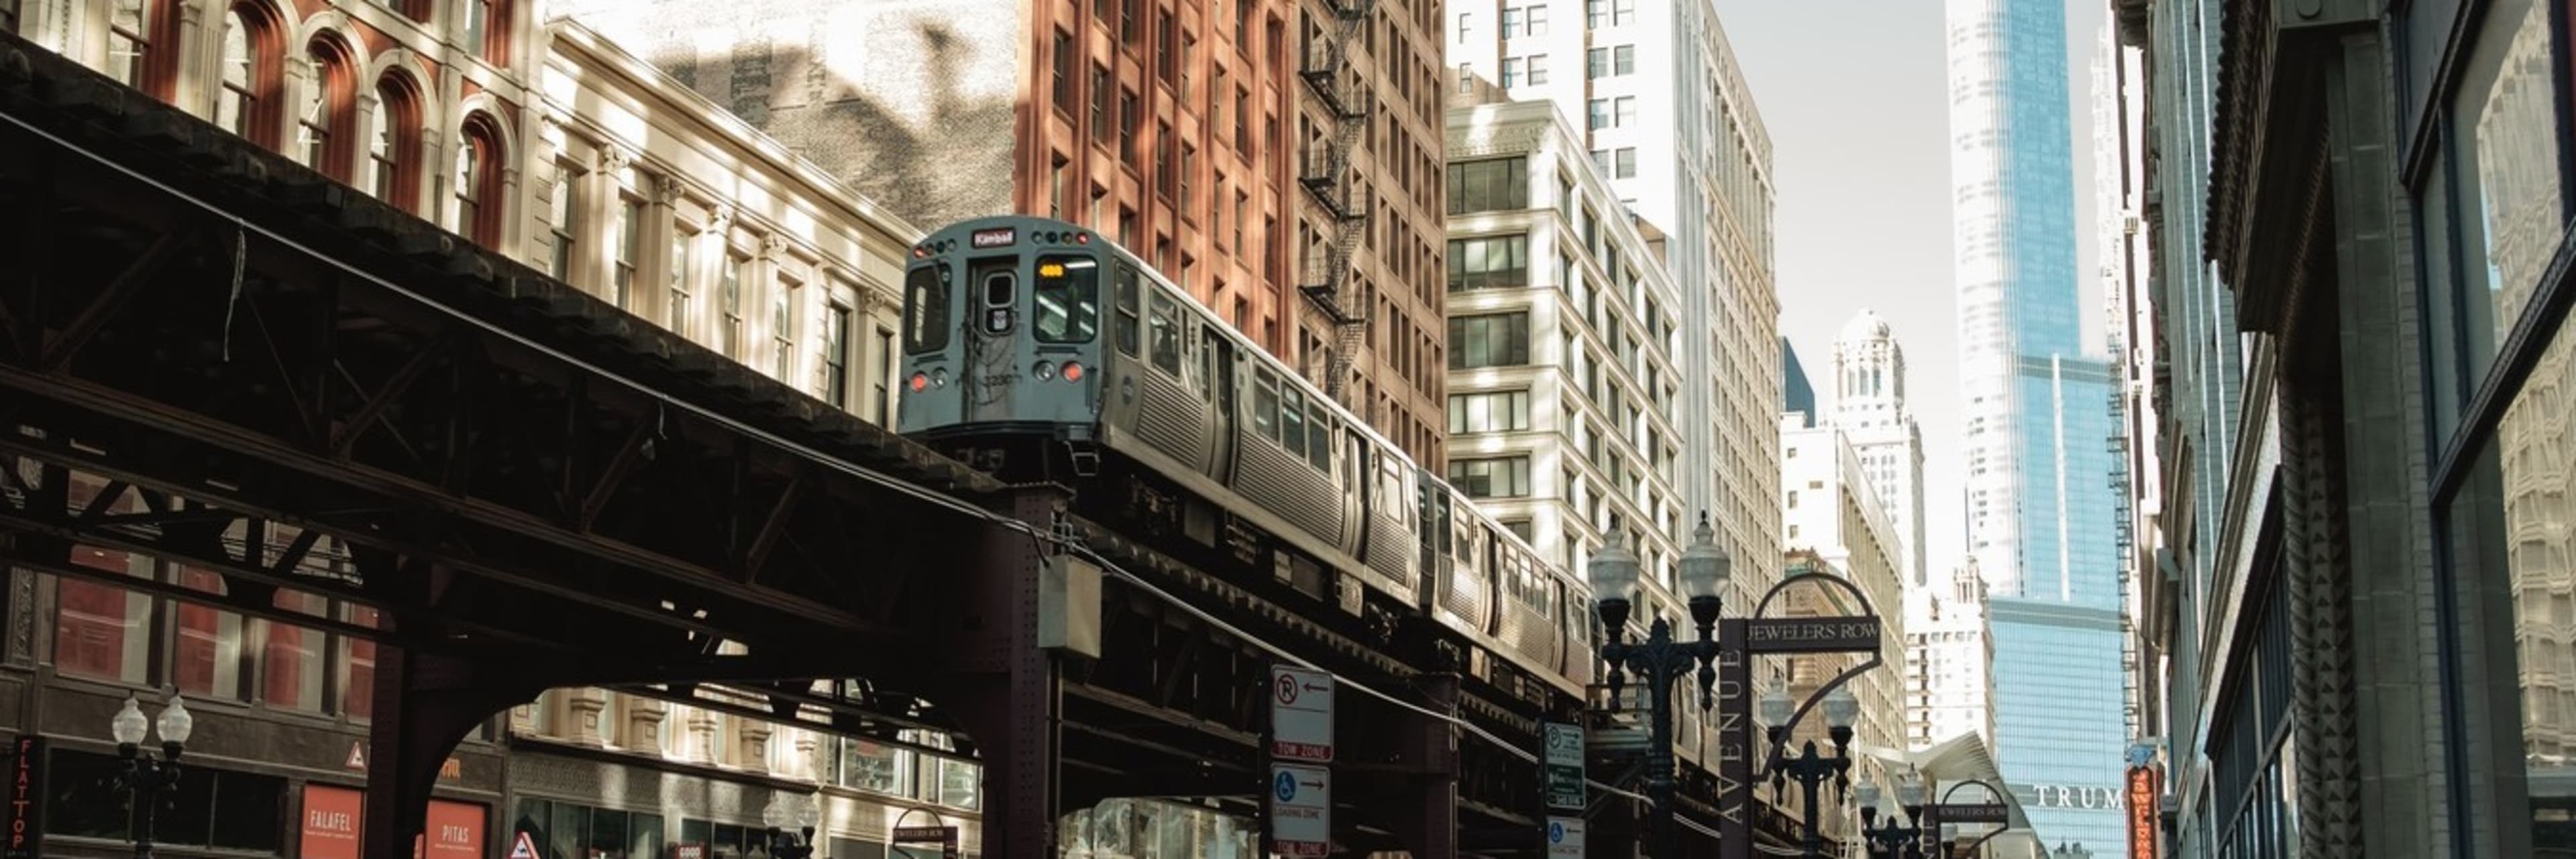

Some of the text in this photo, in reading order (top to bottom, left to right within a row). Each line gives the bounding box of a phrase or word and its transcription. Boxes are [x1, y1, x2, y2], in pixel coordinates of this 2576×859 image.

[1748, 623, 1879, 640] JEWELERS ROW
[1717, 650, 1743, 824] AVENUE
[1277, 742, 1326, 759] TOW ZONE
[311, 810, 350, 831] FALAFEL
[441, 825, 469, 843] PITAS
[1299, 842, 1322, 856] ZONE
